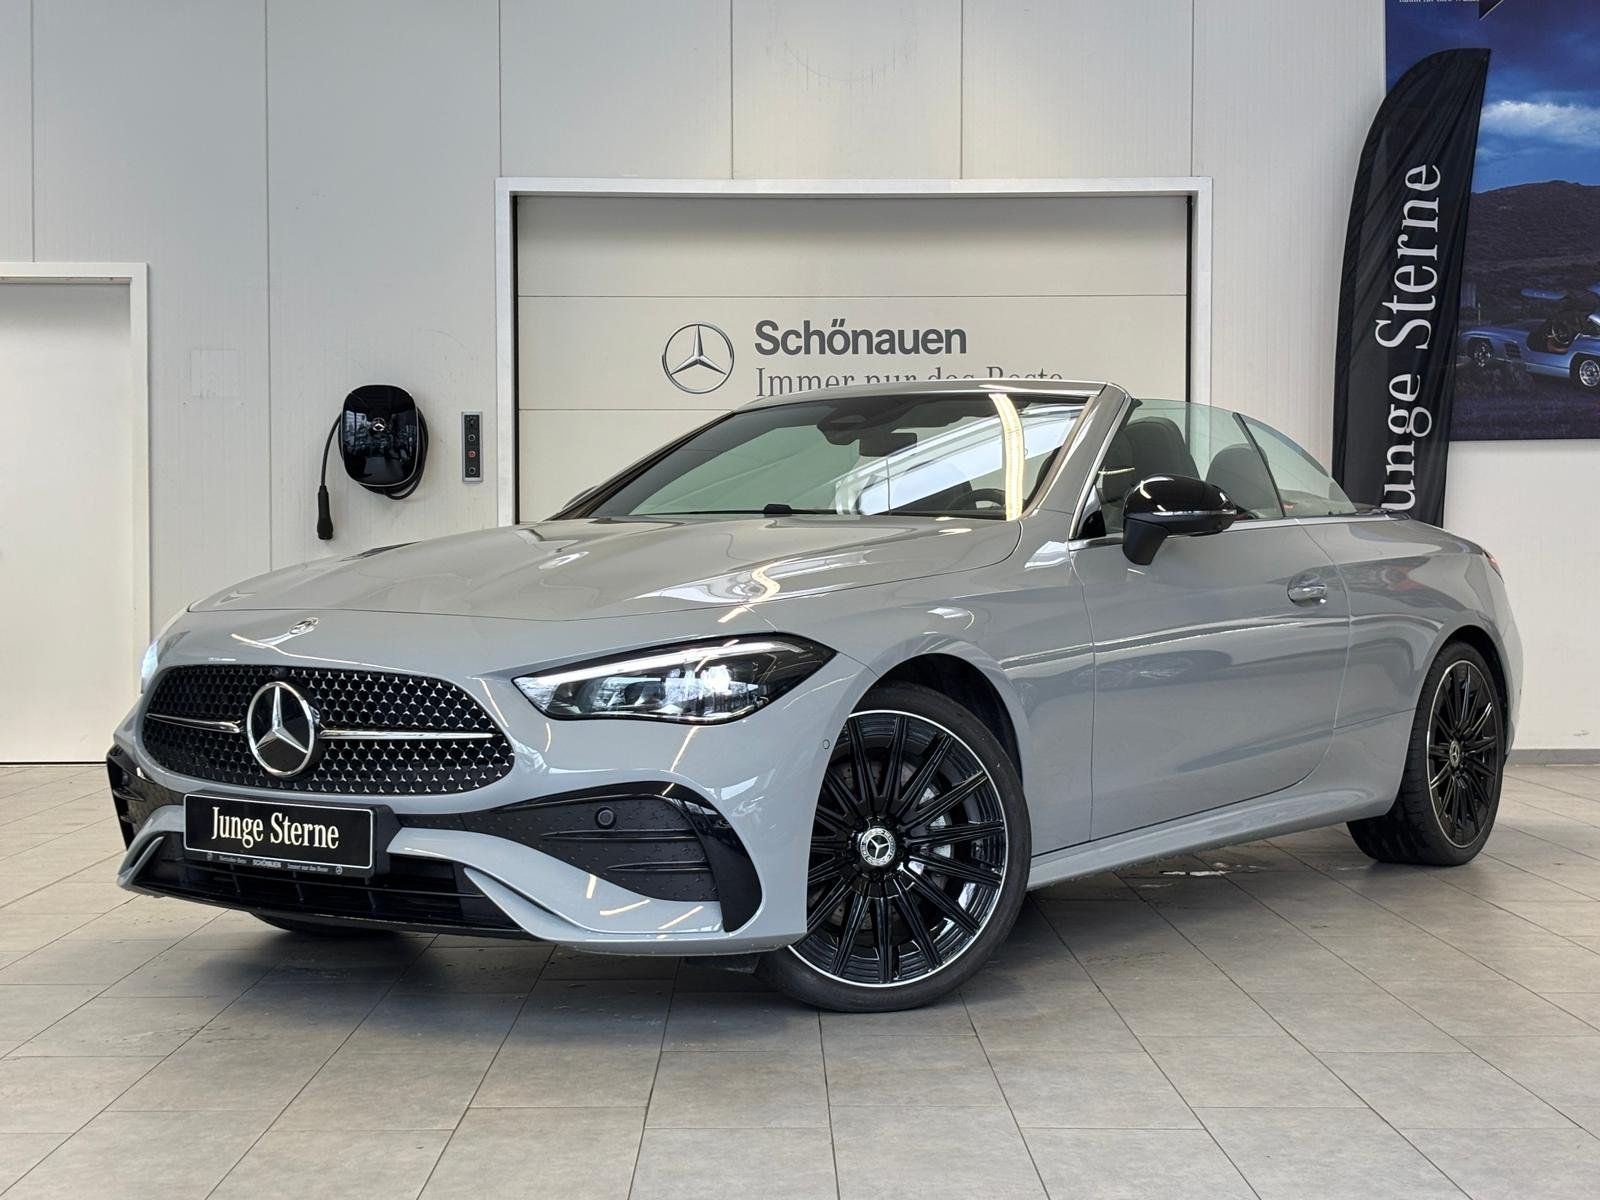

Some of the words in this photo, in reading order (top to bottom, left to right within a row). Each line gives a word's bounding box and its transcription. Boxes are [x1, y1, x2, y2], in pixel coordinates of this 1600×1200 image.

[1375, 163, 1441, 350] Sterne
[754, 318, 967, 356] Schönauen
[1380, 373, 1432, 511] unge
[211, 806, 264, 849] Junge
[270, 812, 340, 850] Sterne
